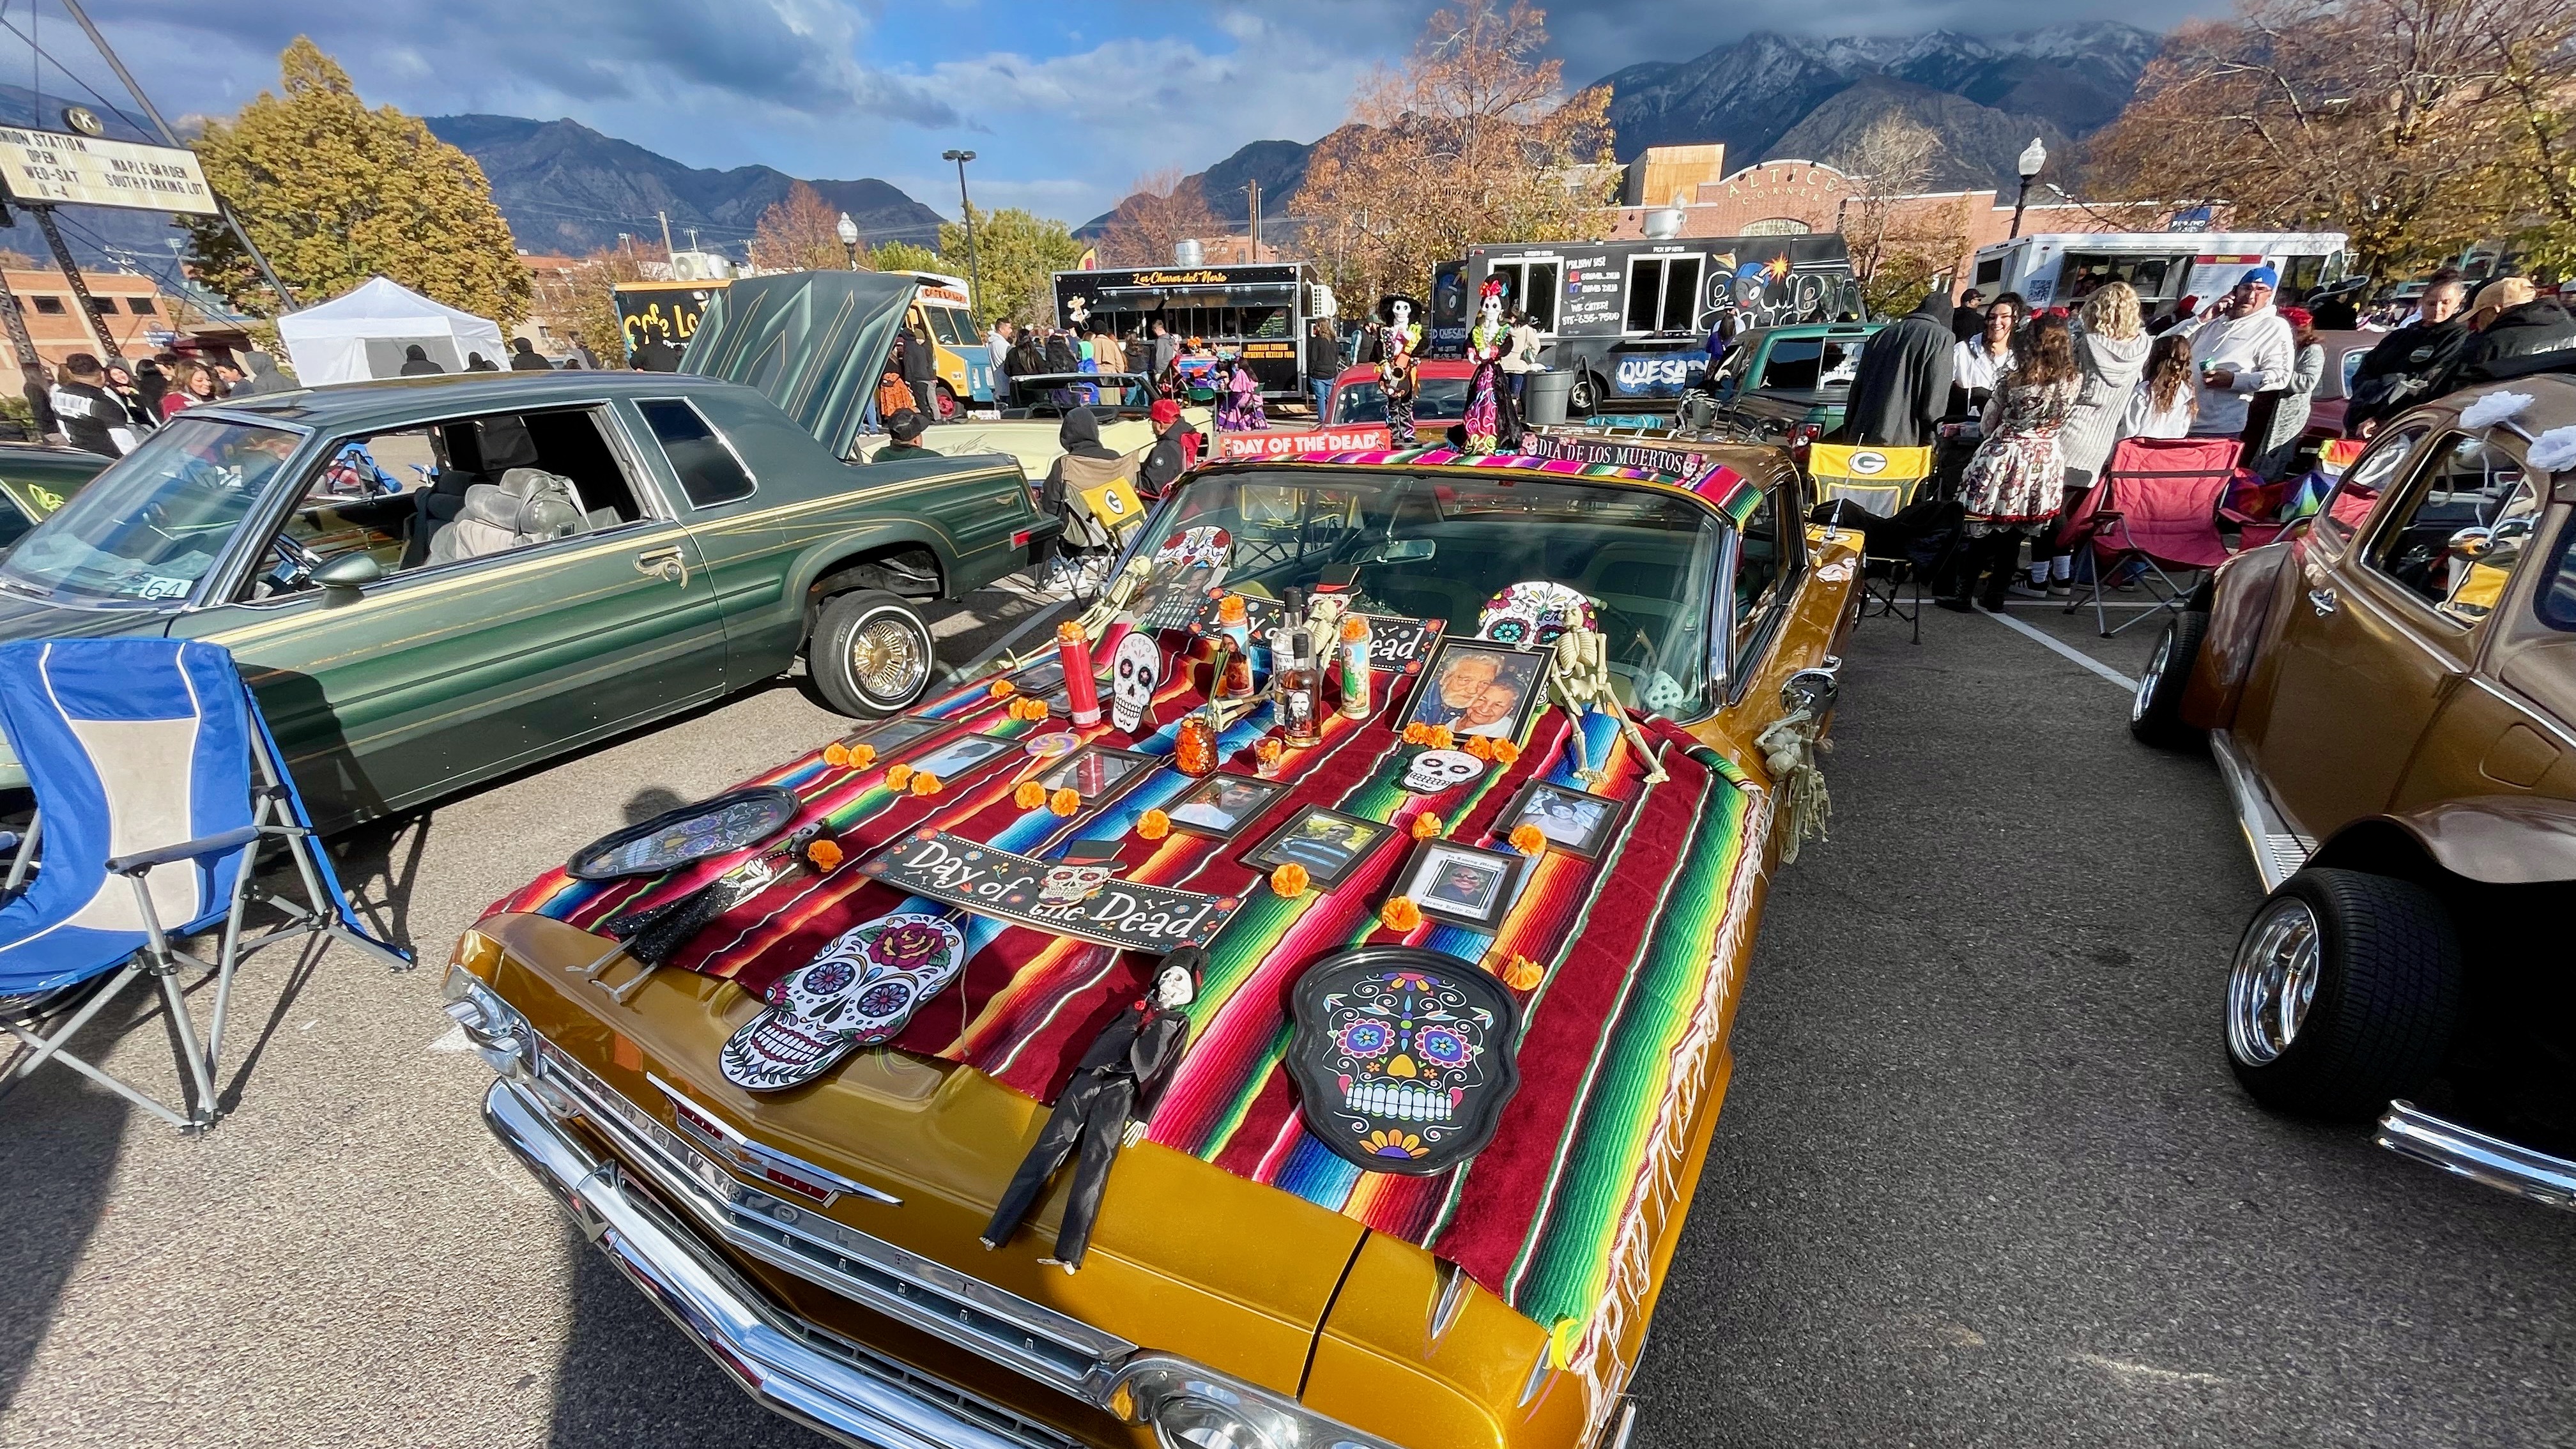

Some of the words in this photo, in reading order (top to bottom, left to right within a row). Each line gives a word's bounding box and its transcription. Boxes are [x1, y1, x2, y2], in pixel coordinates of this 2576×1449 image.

[33, 130, 88, 153] STATION
[26, 149, 59, 165] OPEN
[21, 164, 79, 184] WED-SAT
[110, 158, 150, 176] MAPLE
[149, 162, 188, 179] GARDEN
[104, 173, 140, 189] SOUTH
[140, 177, 185, 193] PARKING
[187, 182, 205, 195] LOT
[1729, 168, 1837, 198] ALTICE
[1570, 302, 1584, 312] WE
[1232, 438, 1266, 455] DAY
[1268, 437, 1292, 453] OF
[1294, 435, 1326, 452] THE
[1329, 434, 1377, 451] DEAD
[1538, 438, 1563, 460] DIA
[1567, 443, 1584, 462] DE
[1587, 445, 1612, 464] LOS
[1614, 447, 1684, 473] MUERTOS
[144, 580, 183, 597] 64
[1367, 627, 1425, 661] ead
[902, 840, 987, 889] Day
[977, 877, 1035, 902] of
[1089, 891, 1214, 939] Dead
